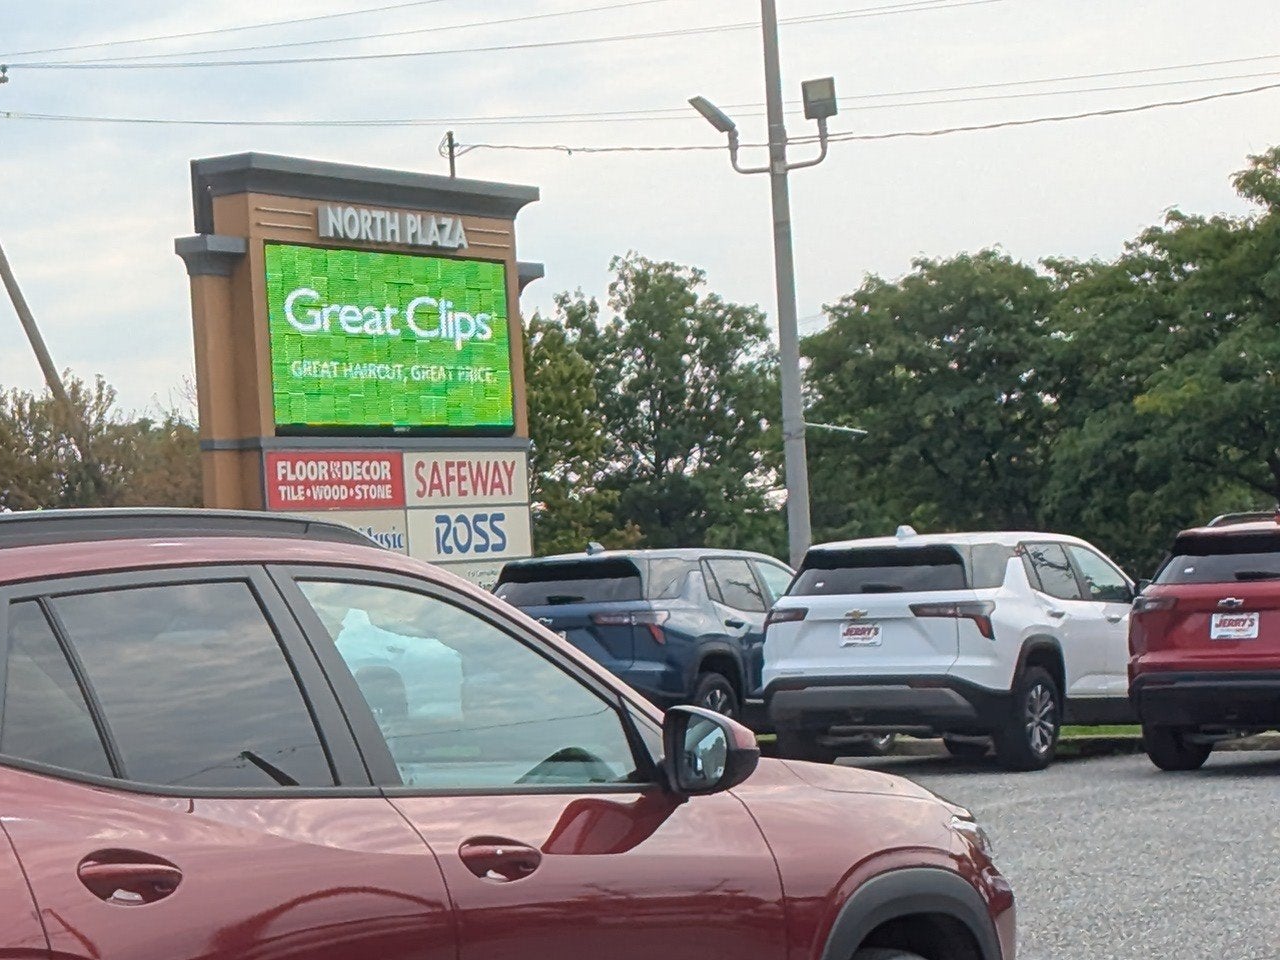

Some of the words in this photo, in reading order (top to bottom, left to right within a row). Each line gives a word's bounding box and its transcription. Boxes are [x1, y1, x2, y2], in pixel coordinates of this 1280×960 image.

[326, 206, 401, 243] NORTH
[406, 214, 469, 249] PLAZA
[284, 287, 401, 334] Great
[406, 296, 493, 350] Clips
[291, 360, 340, 379] GREAT
[344, 362, 408, 383] HAIRCUT,
[410, 364, 454, 382] GREAT
[277, 460, 329, 481] FLOOR
[341, 460, 391, 481] DECOR
[415, 460, 516, 498] SAFEWAY
[278, 485, 305, 501] TILE
[311, 484, 348, 500] WOOD
[354, 484, 393, 500] STONE
[435, 513, 507, 554] ROSS
